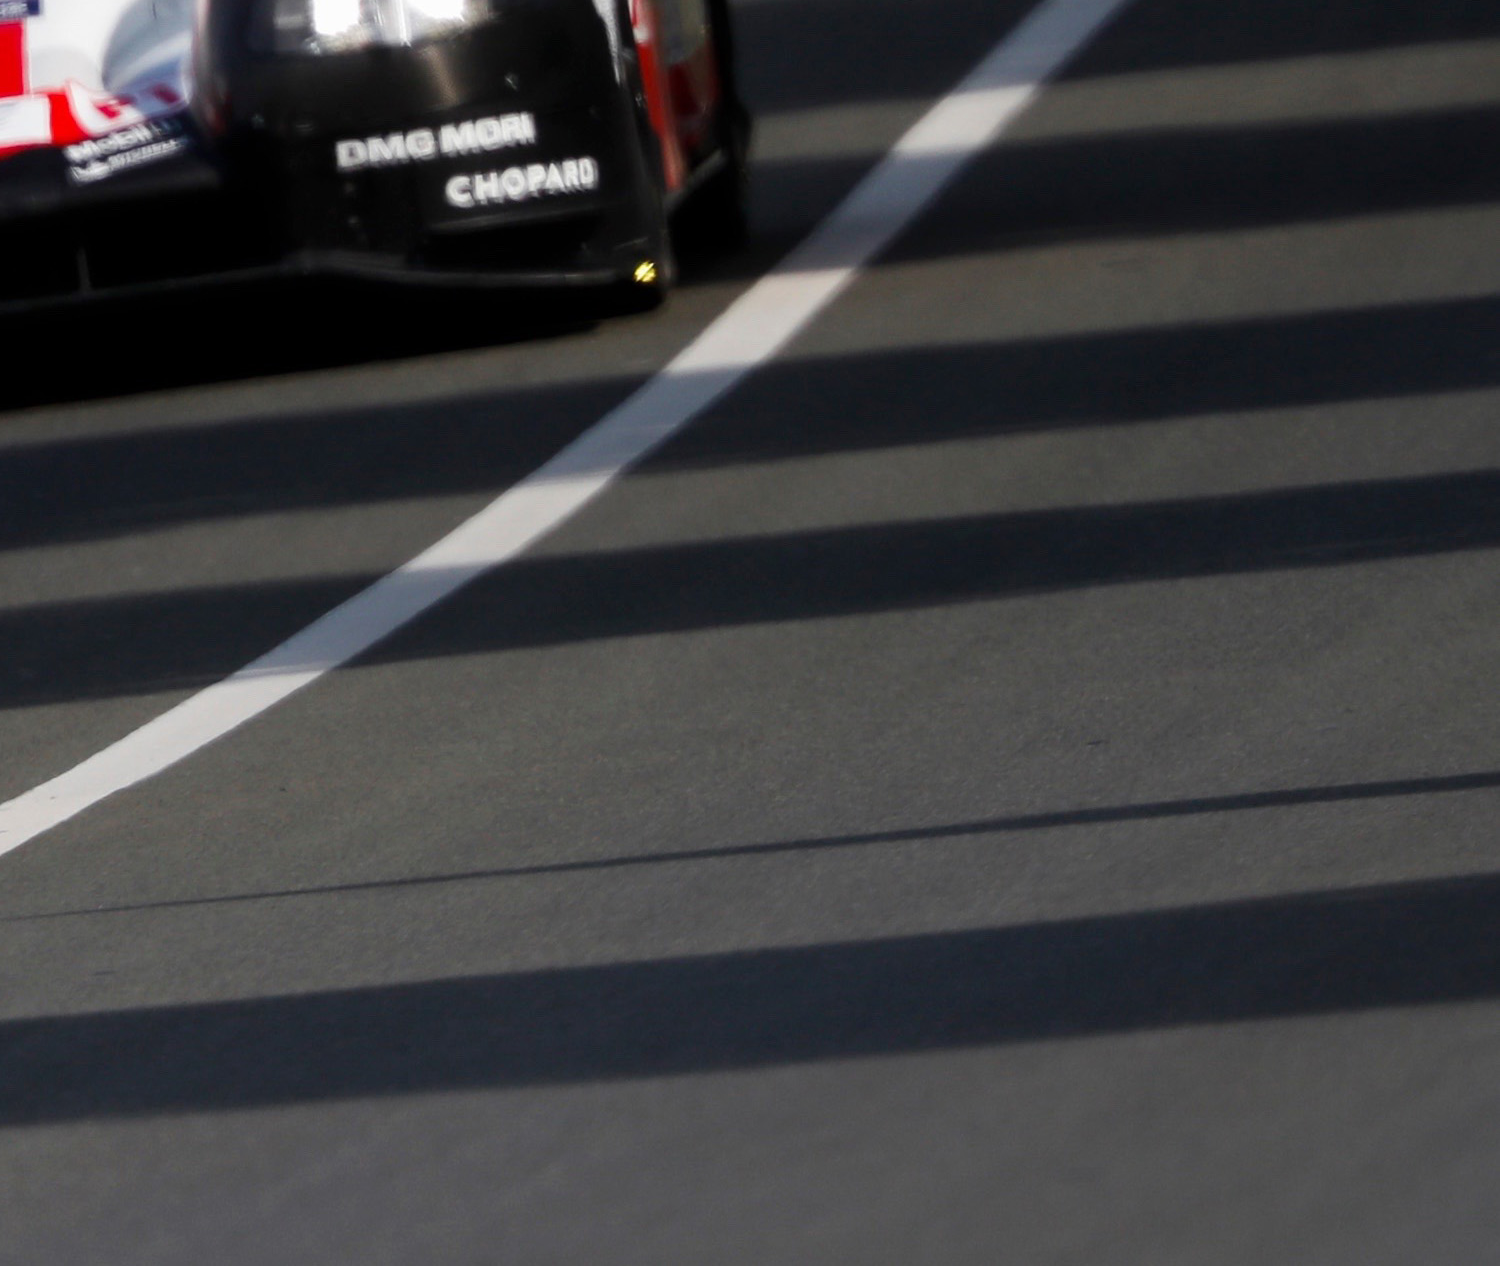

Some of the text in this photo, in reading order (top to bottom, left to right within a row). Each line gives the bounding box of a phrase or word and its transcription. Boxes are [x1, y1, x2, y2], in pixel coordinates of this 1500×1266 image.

[336, 111, 537, 170] DMG MORI
[445, 155, 599, 208] CHOPARD
